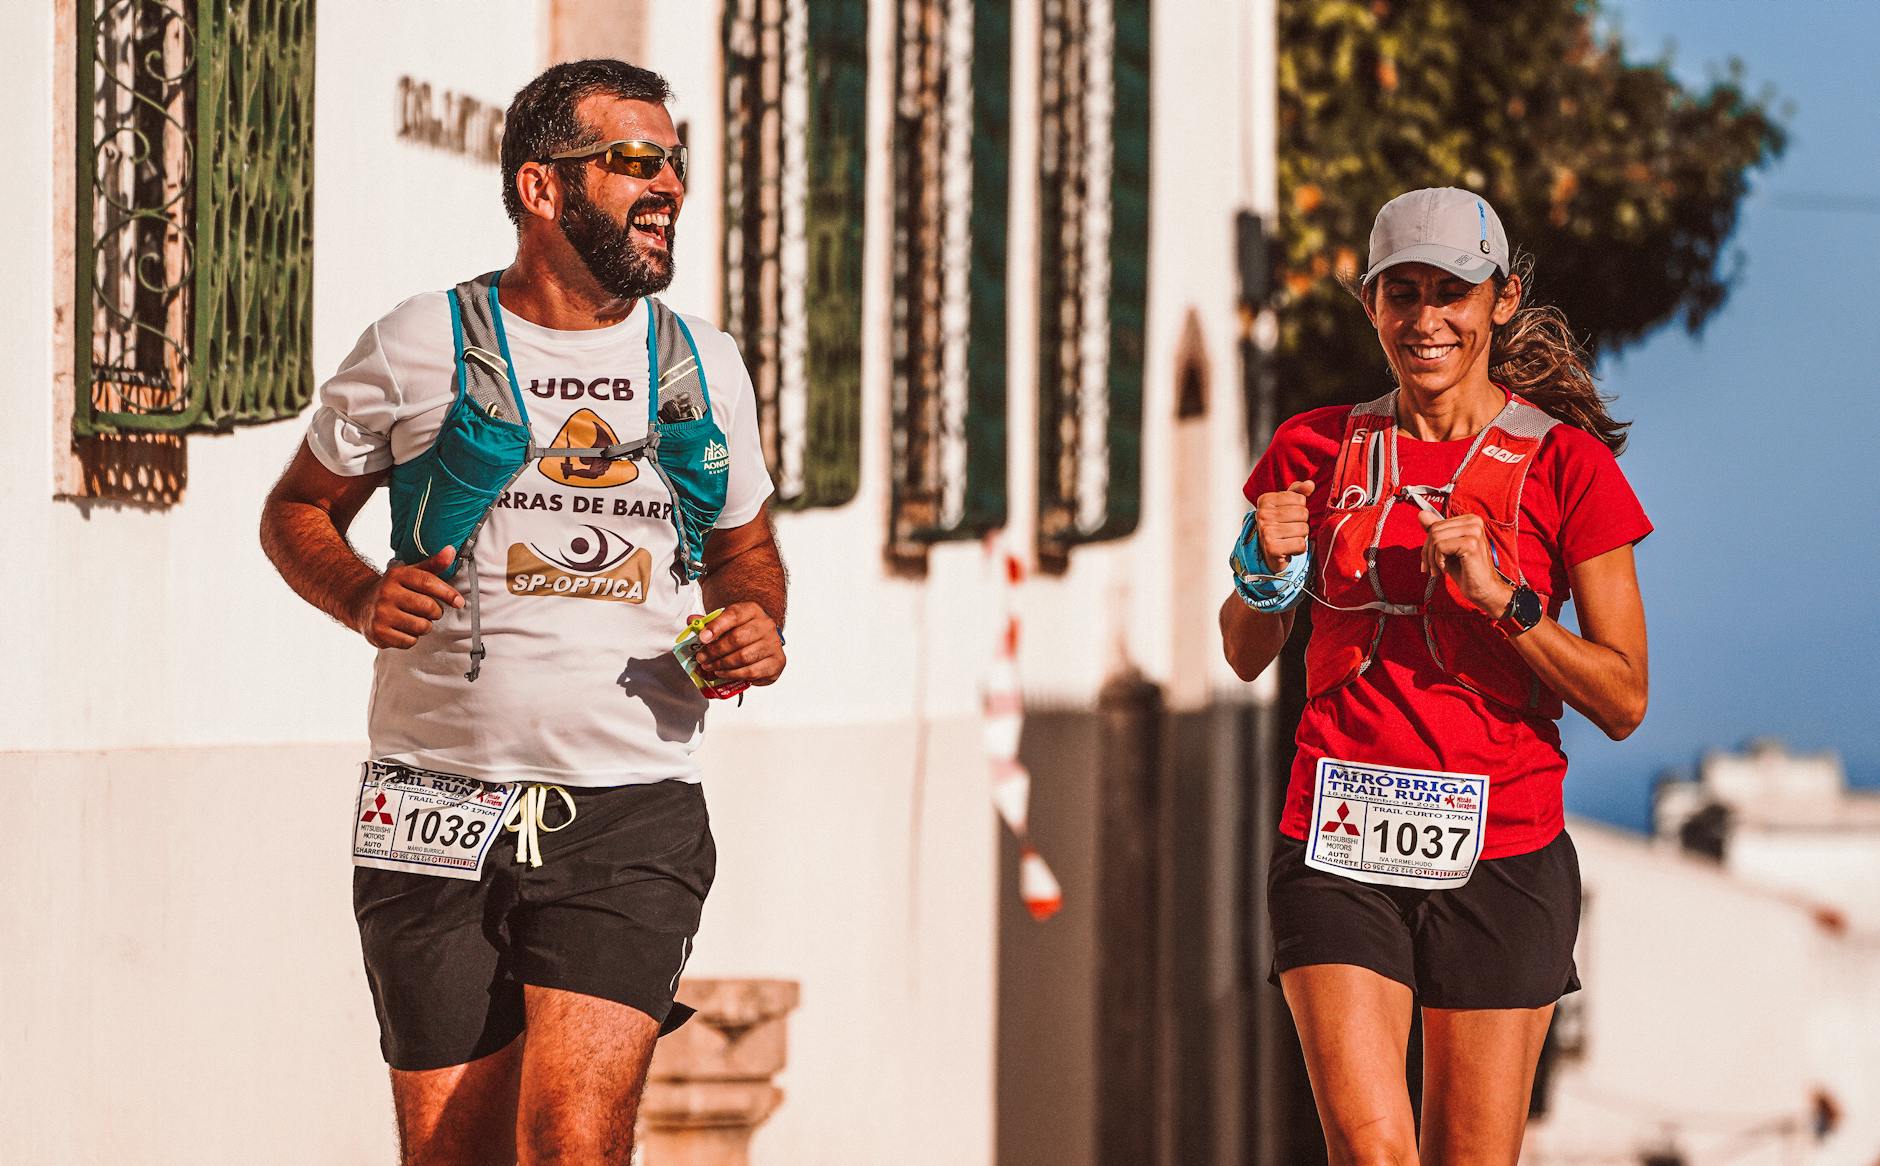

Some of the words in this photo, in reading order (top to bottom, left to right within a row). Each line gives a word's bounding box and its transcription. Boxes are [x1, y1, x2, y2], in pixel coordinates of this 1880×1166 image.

[529, 377, 634, 401] UDCB
[572, 495, 604, 514] DE
[512, 573, 643, 601] SP-OPTICA
[372, 771, 426, 787] TAIL
[1328, 768, 1478, 796] MIRÓBRIGA
[1328, 780, 1388, 798] TRAIL
[1394, 789, 1441, 803] RUN
[408, 794, 434, 804] TRAIL
[471, 807, 496, 817] 17KM
[1373, 806, 1402, 815] TRAIL
[1405, 810, 1442, 818] CURTO
[1446, 814, 1473, 822] 17KM
[360, 824, 392, 834] MITSUBISHI
[405, 808, 486, 849] 1038
[363, 833, 385, 841] MOTORS
[1322, 834, 1359, 845] MITSUBISHI
[1373, 819, 1471, 861] 1037
[355, 847, 388, 857] CHARRETE
[1326, 842, 1352, 852] MOTORS
[1327, 850, 1349, 859] AUTO
[1316, 854, 1359, 867] CHARRETE
